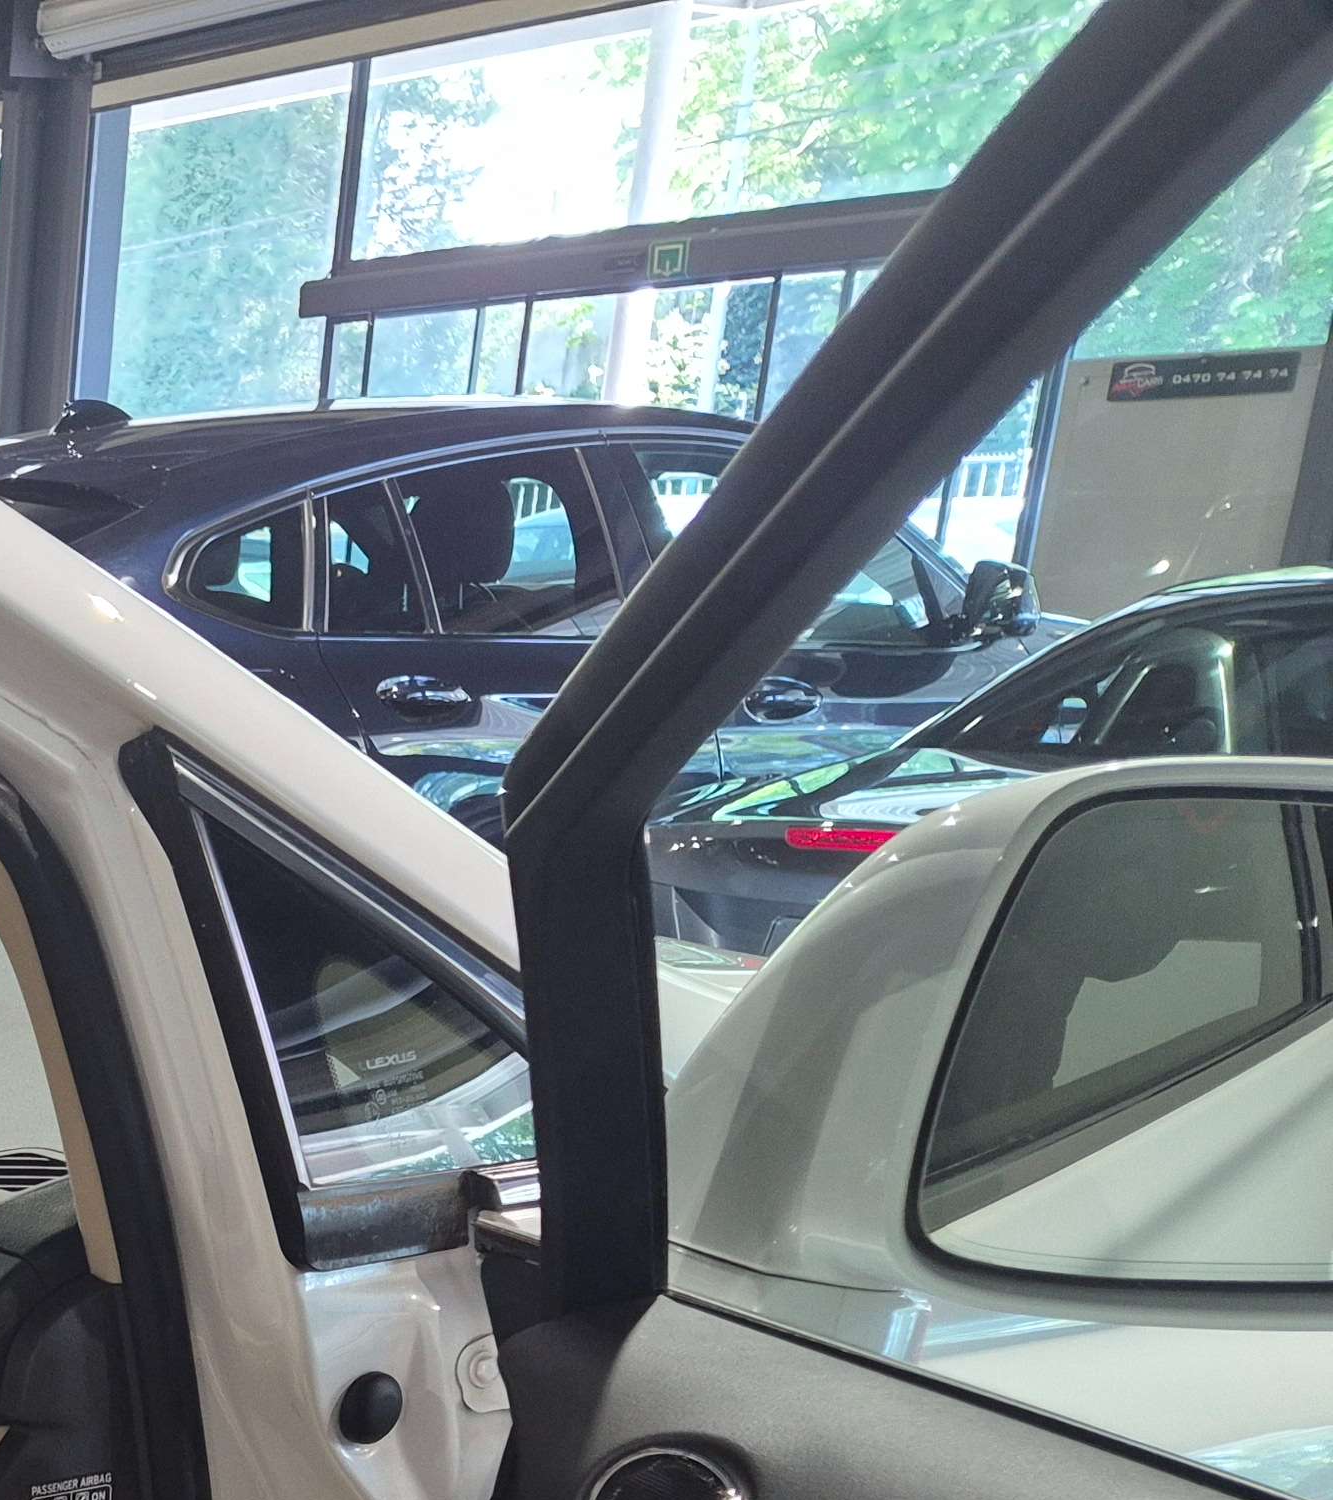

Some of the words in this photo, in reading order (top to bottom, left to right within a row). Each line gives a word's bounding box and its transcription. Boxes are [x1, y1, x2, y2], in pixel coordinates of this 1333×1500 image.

[1172, 373, 1211, 385] 0470
[1215, 372, 1237, 382] 74
[1242, 370, 1263, 380] 74
[1268, 367, 1290, 378] 74
[365, 1050, 417, 1070] LEXUS
[31, 1478, 78, 1496] PASSENGER
[79, 1472, 112, 1488] AIRBAG
